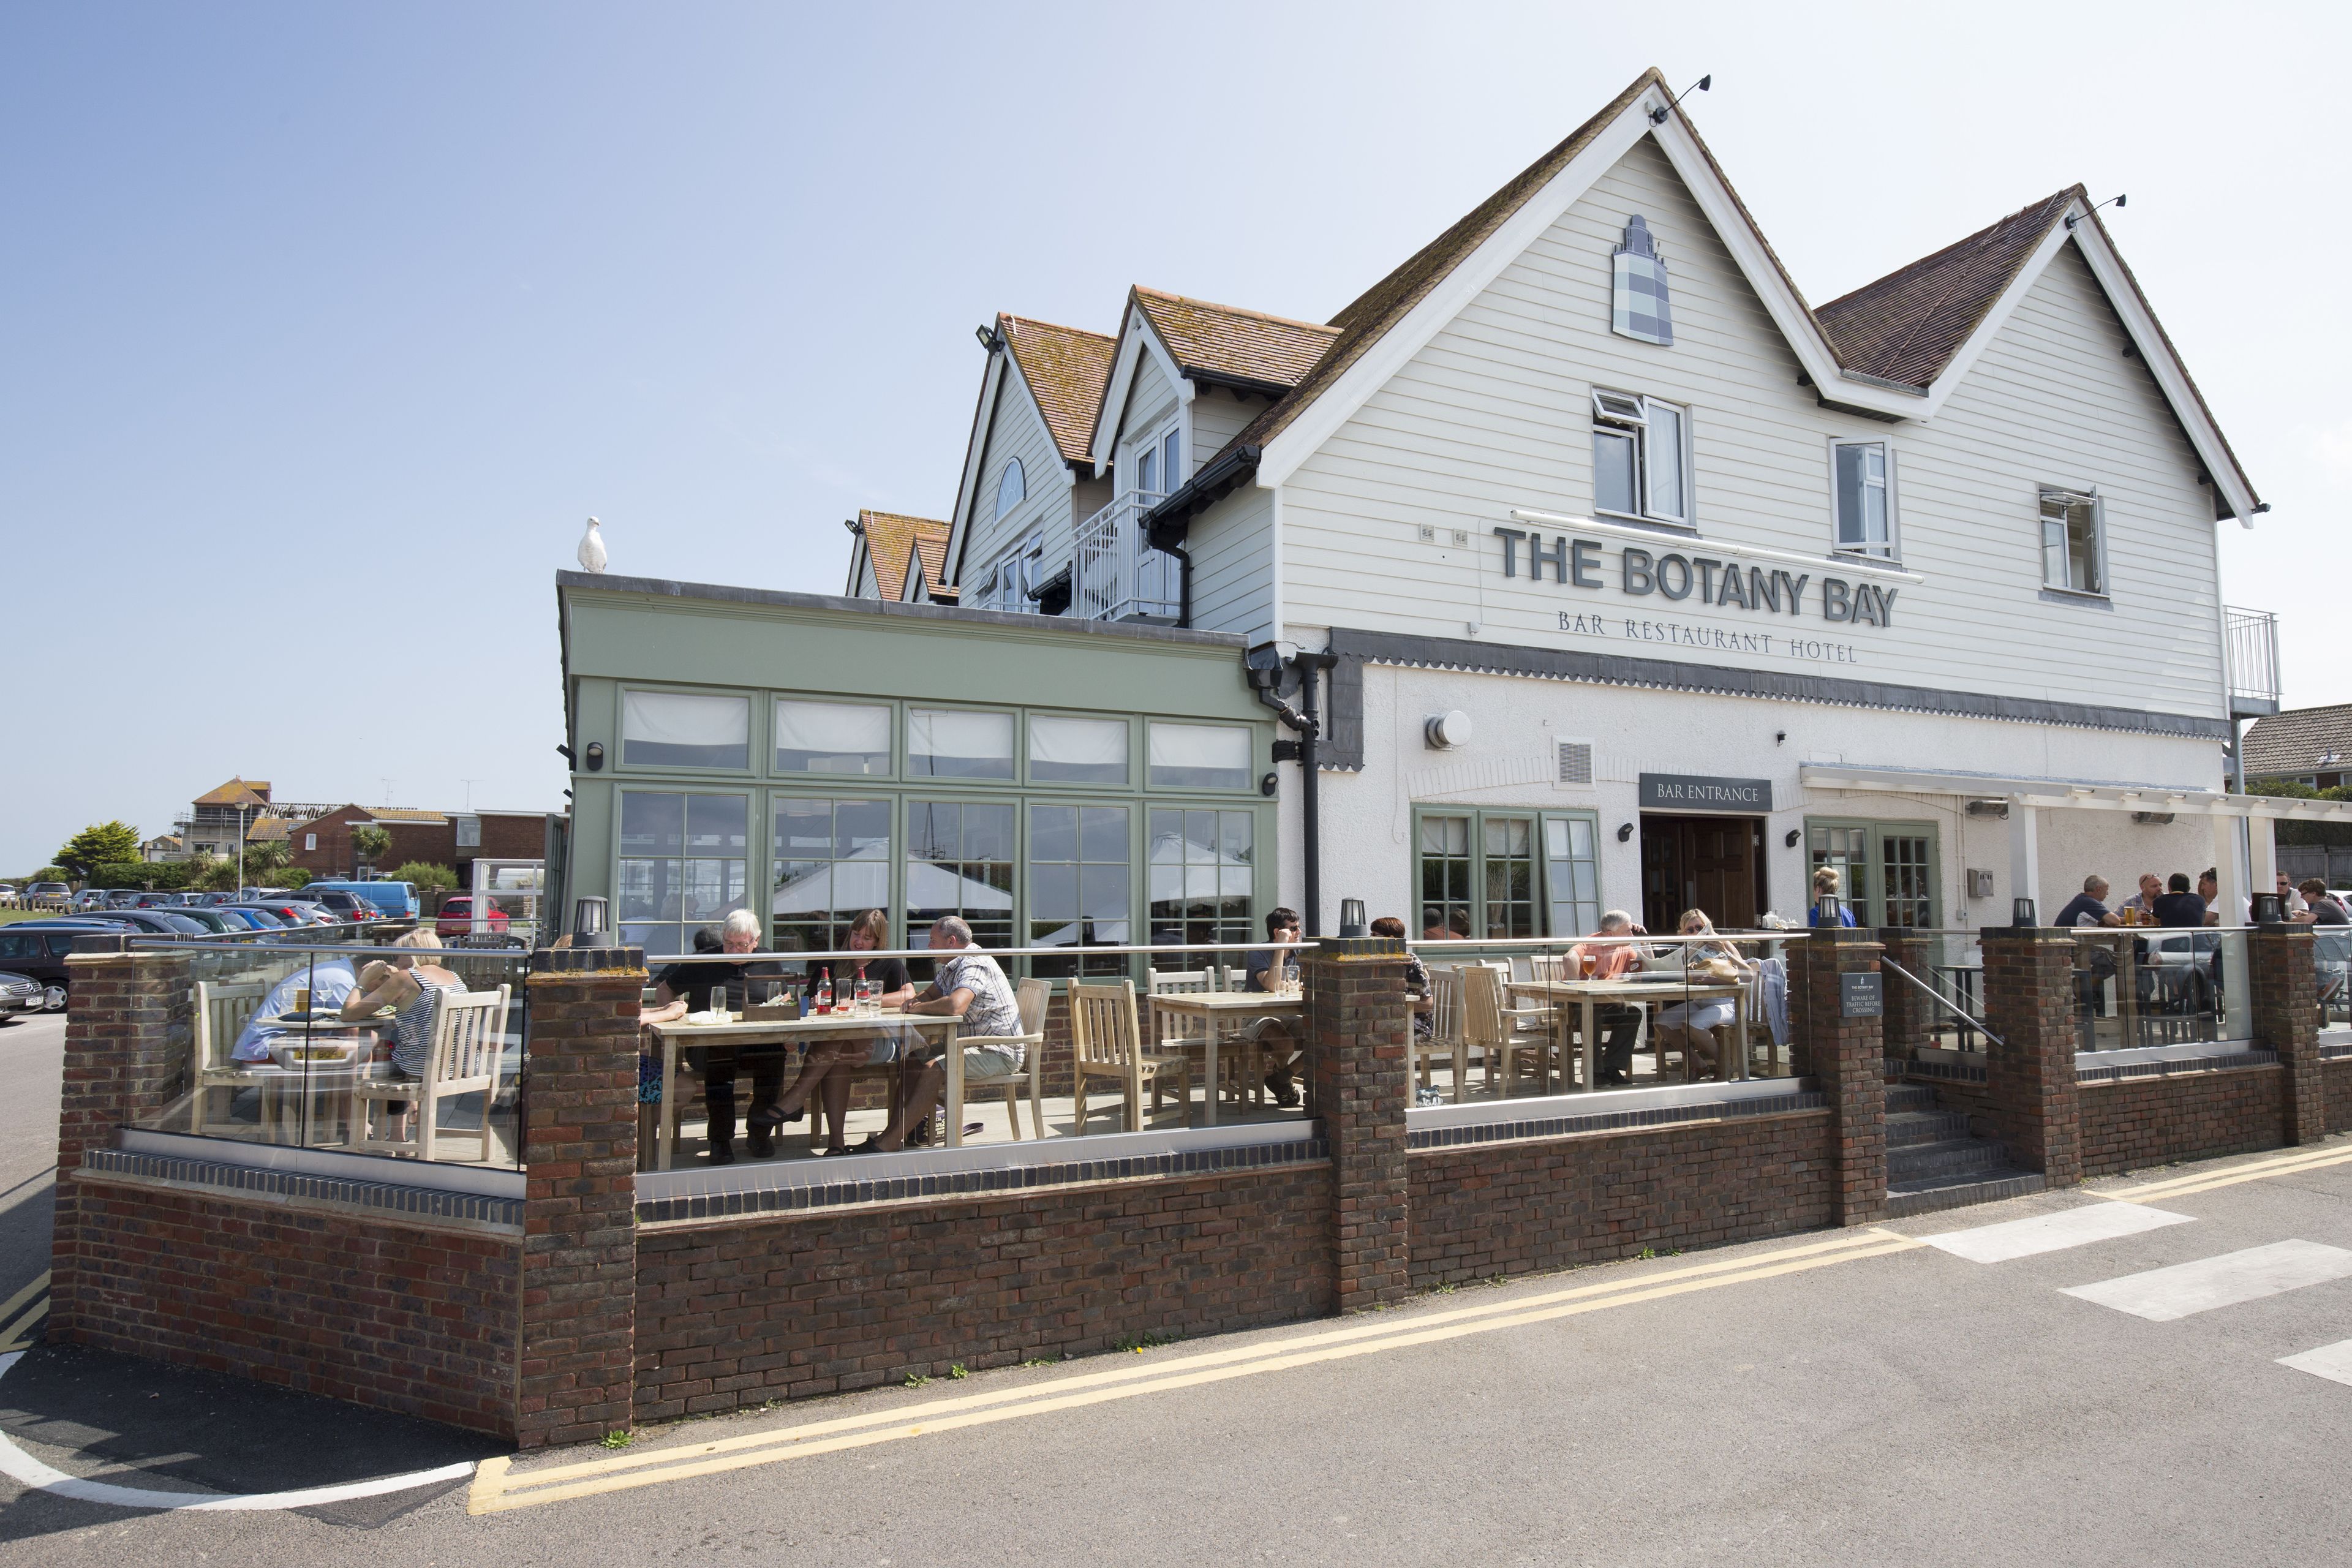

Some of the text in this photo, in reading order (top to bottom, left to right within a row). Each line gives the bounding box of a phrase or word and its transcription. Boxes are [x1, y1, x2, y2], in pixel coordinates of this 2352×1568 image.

[1494, 527, 1898, 627] THE BOTANY BAY
[1558, 611, 1856, 663] BAR RESTAURANT HOTEL
[1657, 783, 1758, 802] BAR ENTRANCE
